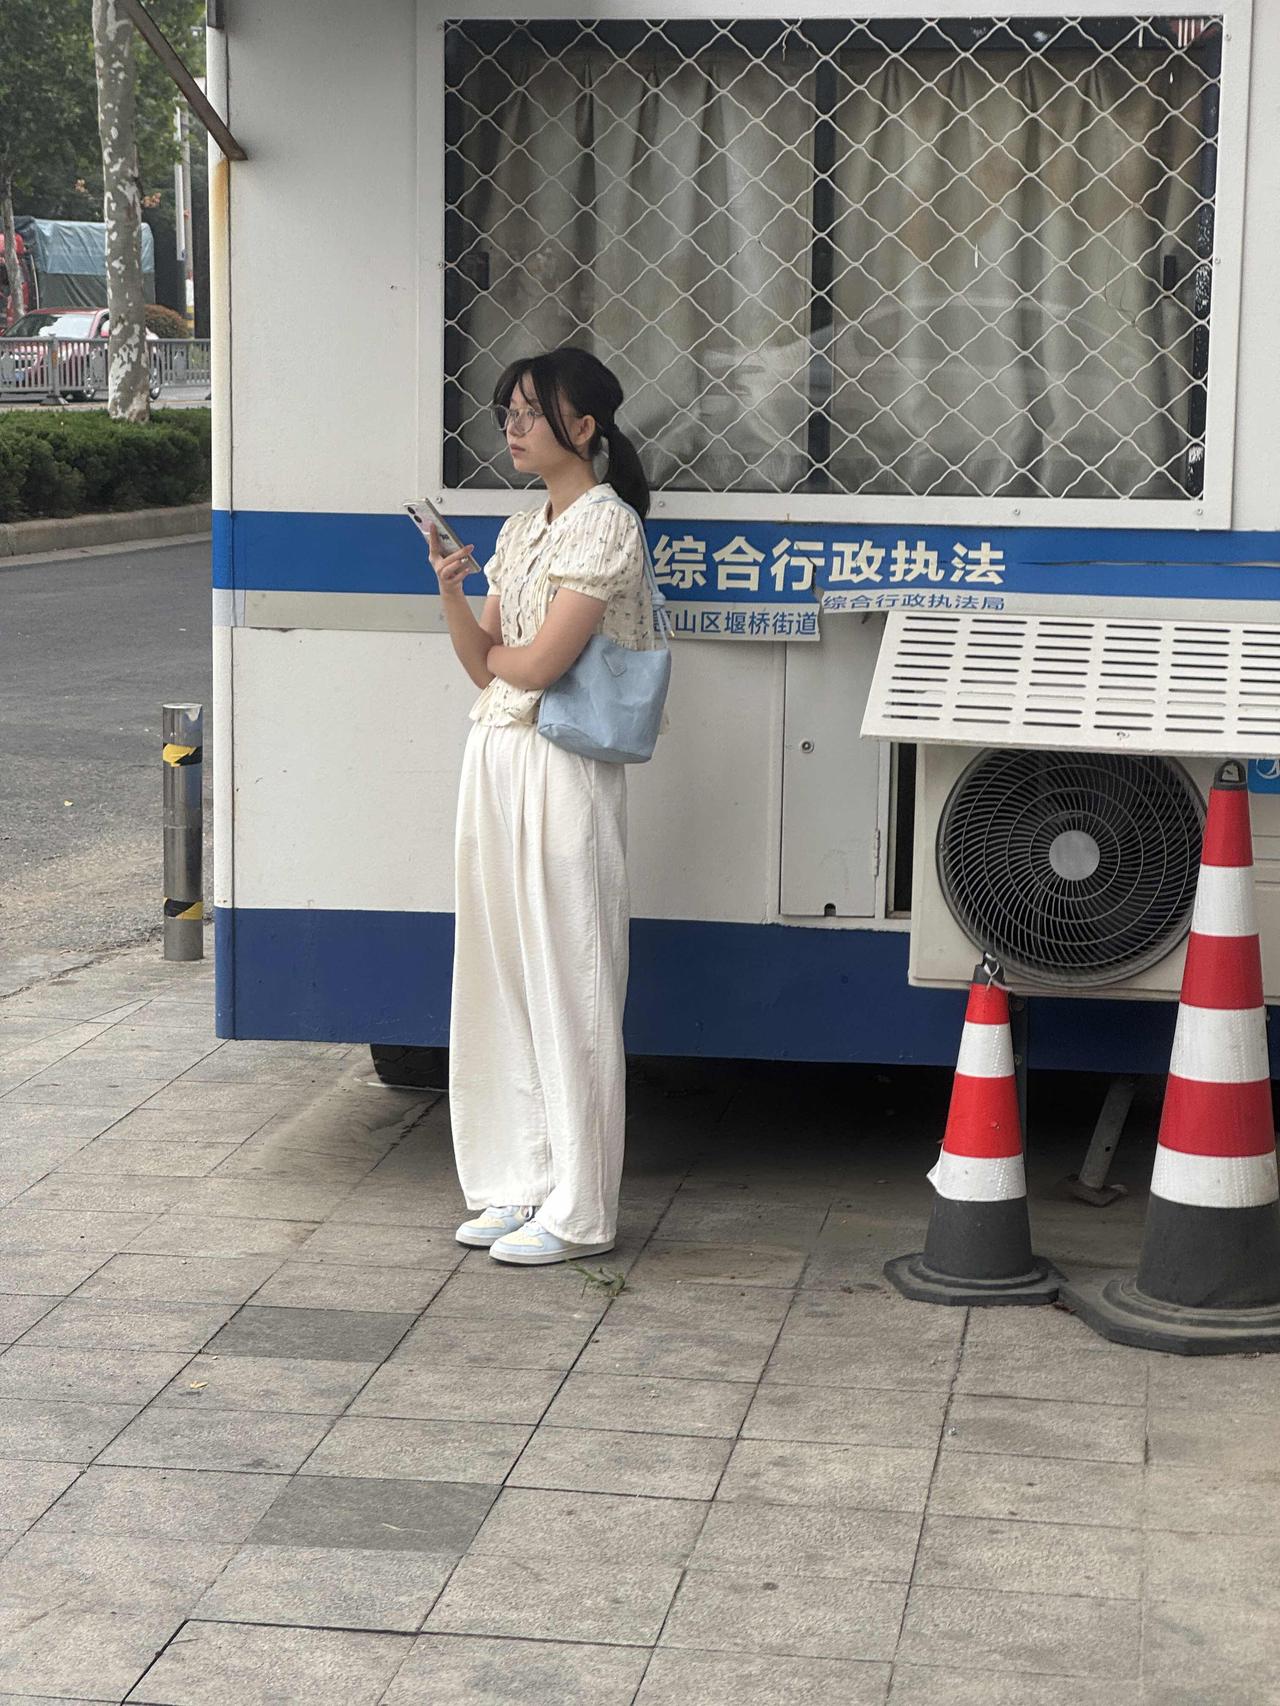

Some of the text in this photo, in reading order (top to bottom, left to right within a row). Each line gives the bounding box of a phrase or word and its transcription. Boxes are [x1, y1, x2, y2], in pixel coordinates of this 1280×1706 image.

[653, 535, 1006, 592] 综合行政执法
[823, 593, 1005, 611] 综合行政执法局
